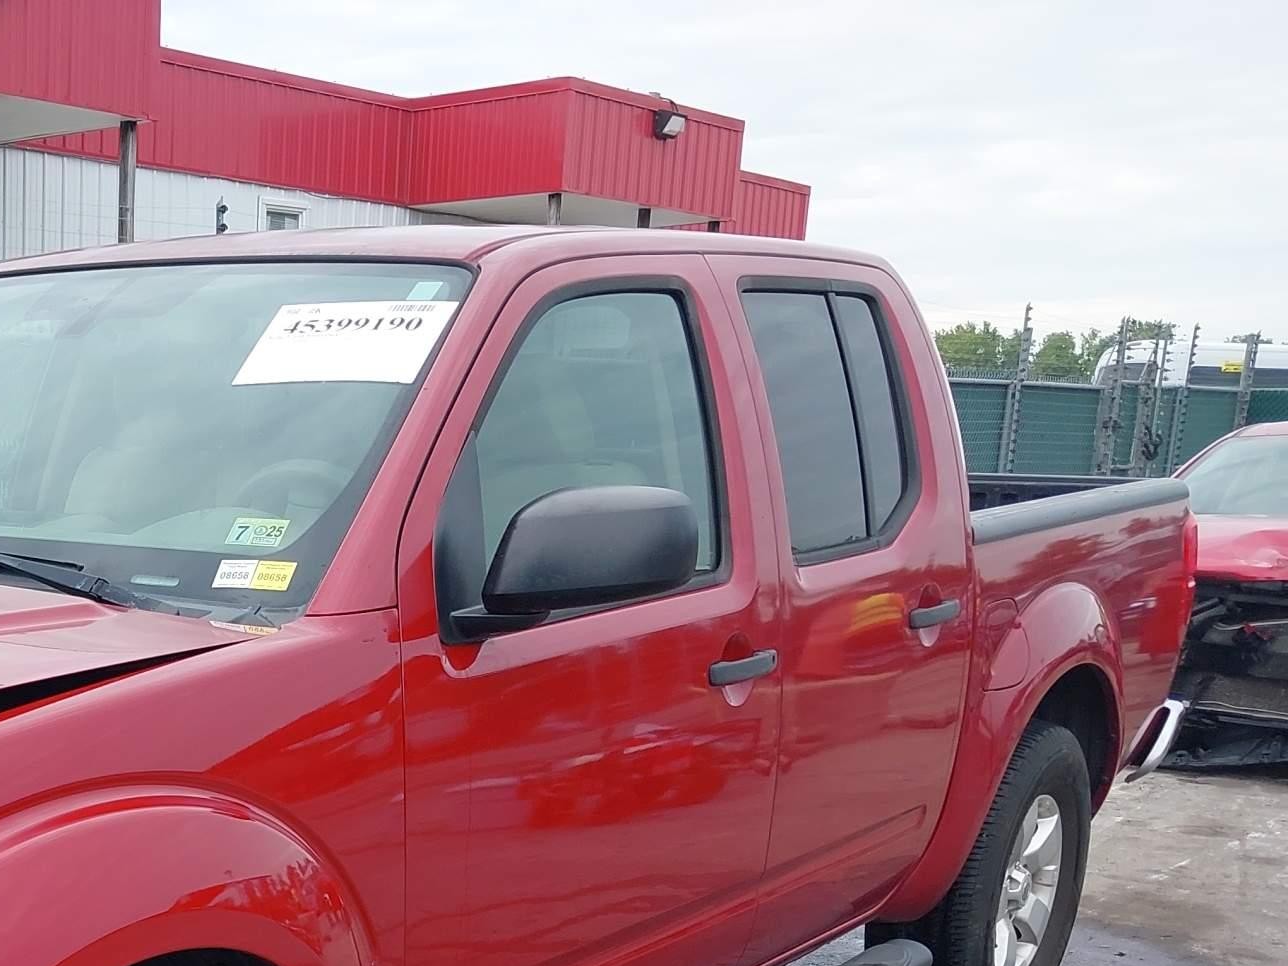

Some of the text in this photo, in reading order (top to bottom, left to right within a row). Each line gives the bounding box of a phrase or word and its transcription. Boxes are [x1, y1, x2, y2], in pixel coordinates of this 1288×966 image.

[284, 317, 423, 334] 45399190
[235, 526, 250, 541] 7
[266, 525, 285, 537] 25
